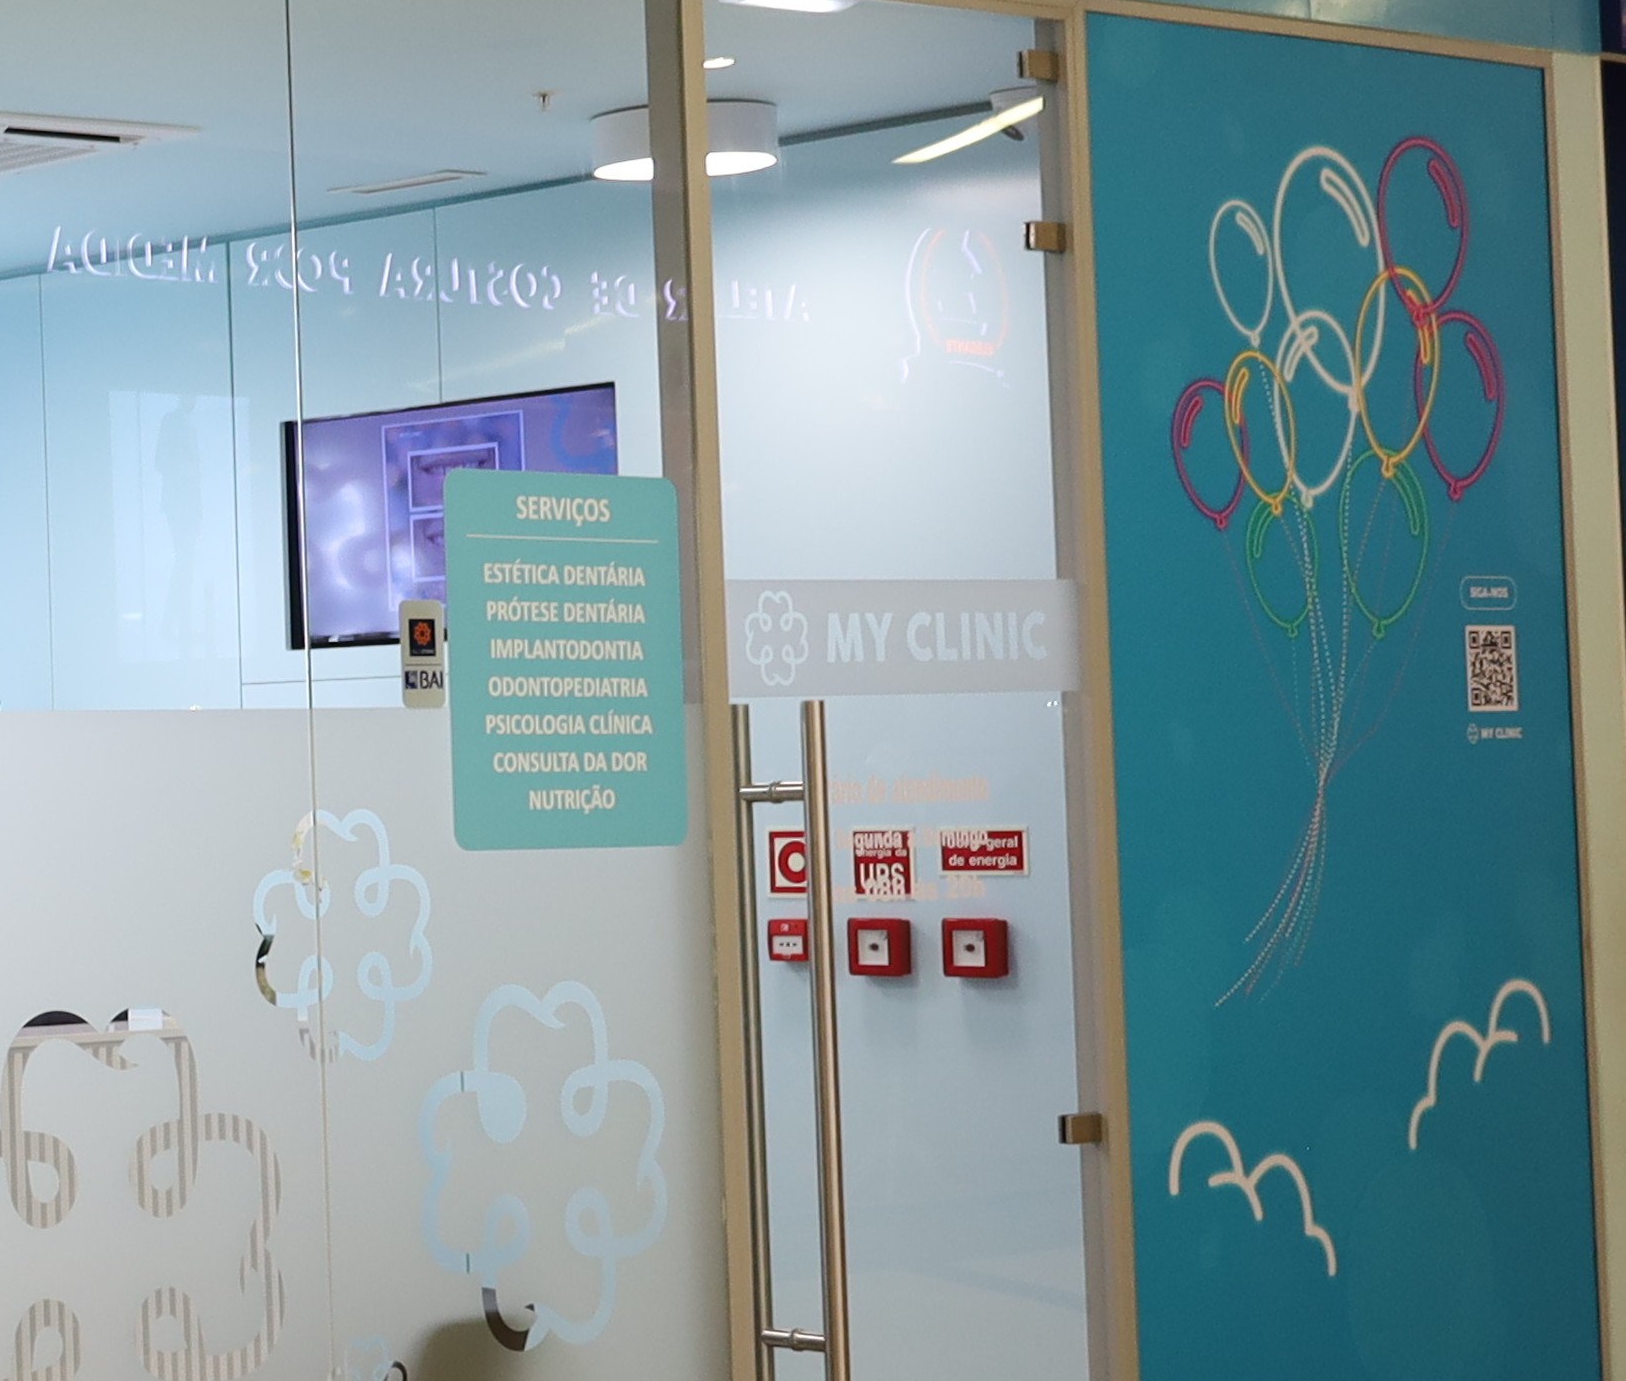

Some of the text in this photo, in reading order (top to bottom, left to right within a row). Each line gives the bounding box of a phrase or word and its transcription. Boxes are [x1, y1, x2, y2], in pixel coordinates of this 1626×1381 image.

[516, 496, 611, 526] SERVIÇOS
[483, 559, 645, 587] ESTÉTICA DENTÁRIA
[486, 596, 645, 623] PRÓTESE DENTÁRIA
[826, 611, 1048, 663] MY CLINIC
[490, 638, 644, 661] IMPLANTODONTIA
[488, 676, 648, 698] ODONTOPEDIATRIA
[485, 709, 652, 735] PSICOLOGIA CLÍNICA
[1481, 727, 1523, 738] MY CLINIC
[493, 752, 647, 773] CONSULTA DA DOR
[529, 784, 615, 814] NUTRIÇÃO
[987, 835, 1018, 851] geral
[949, 853, 1017, 868] de energia
